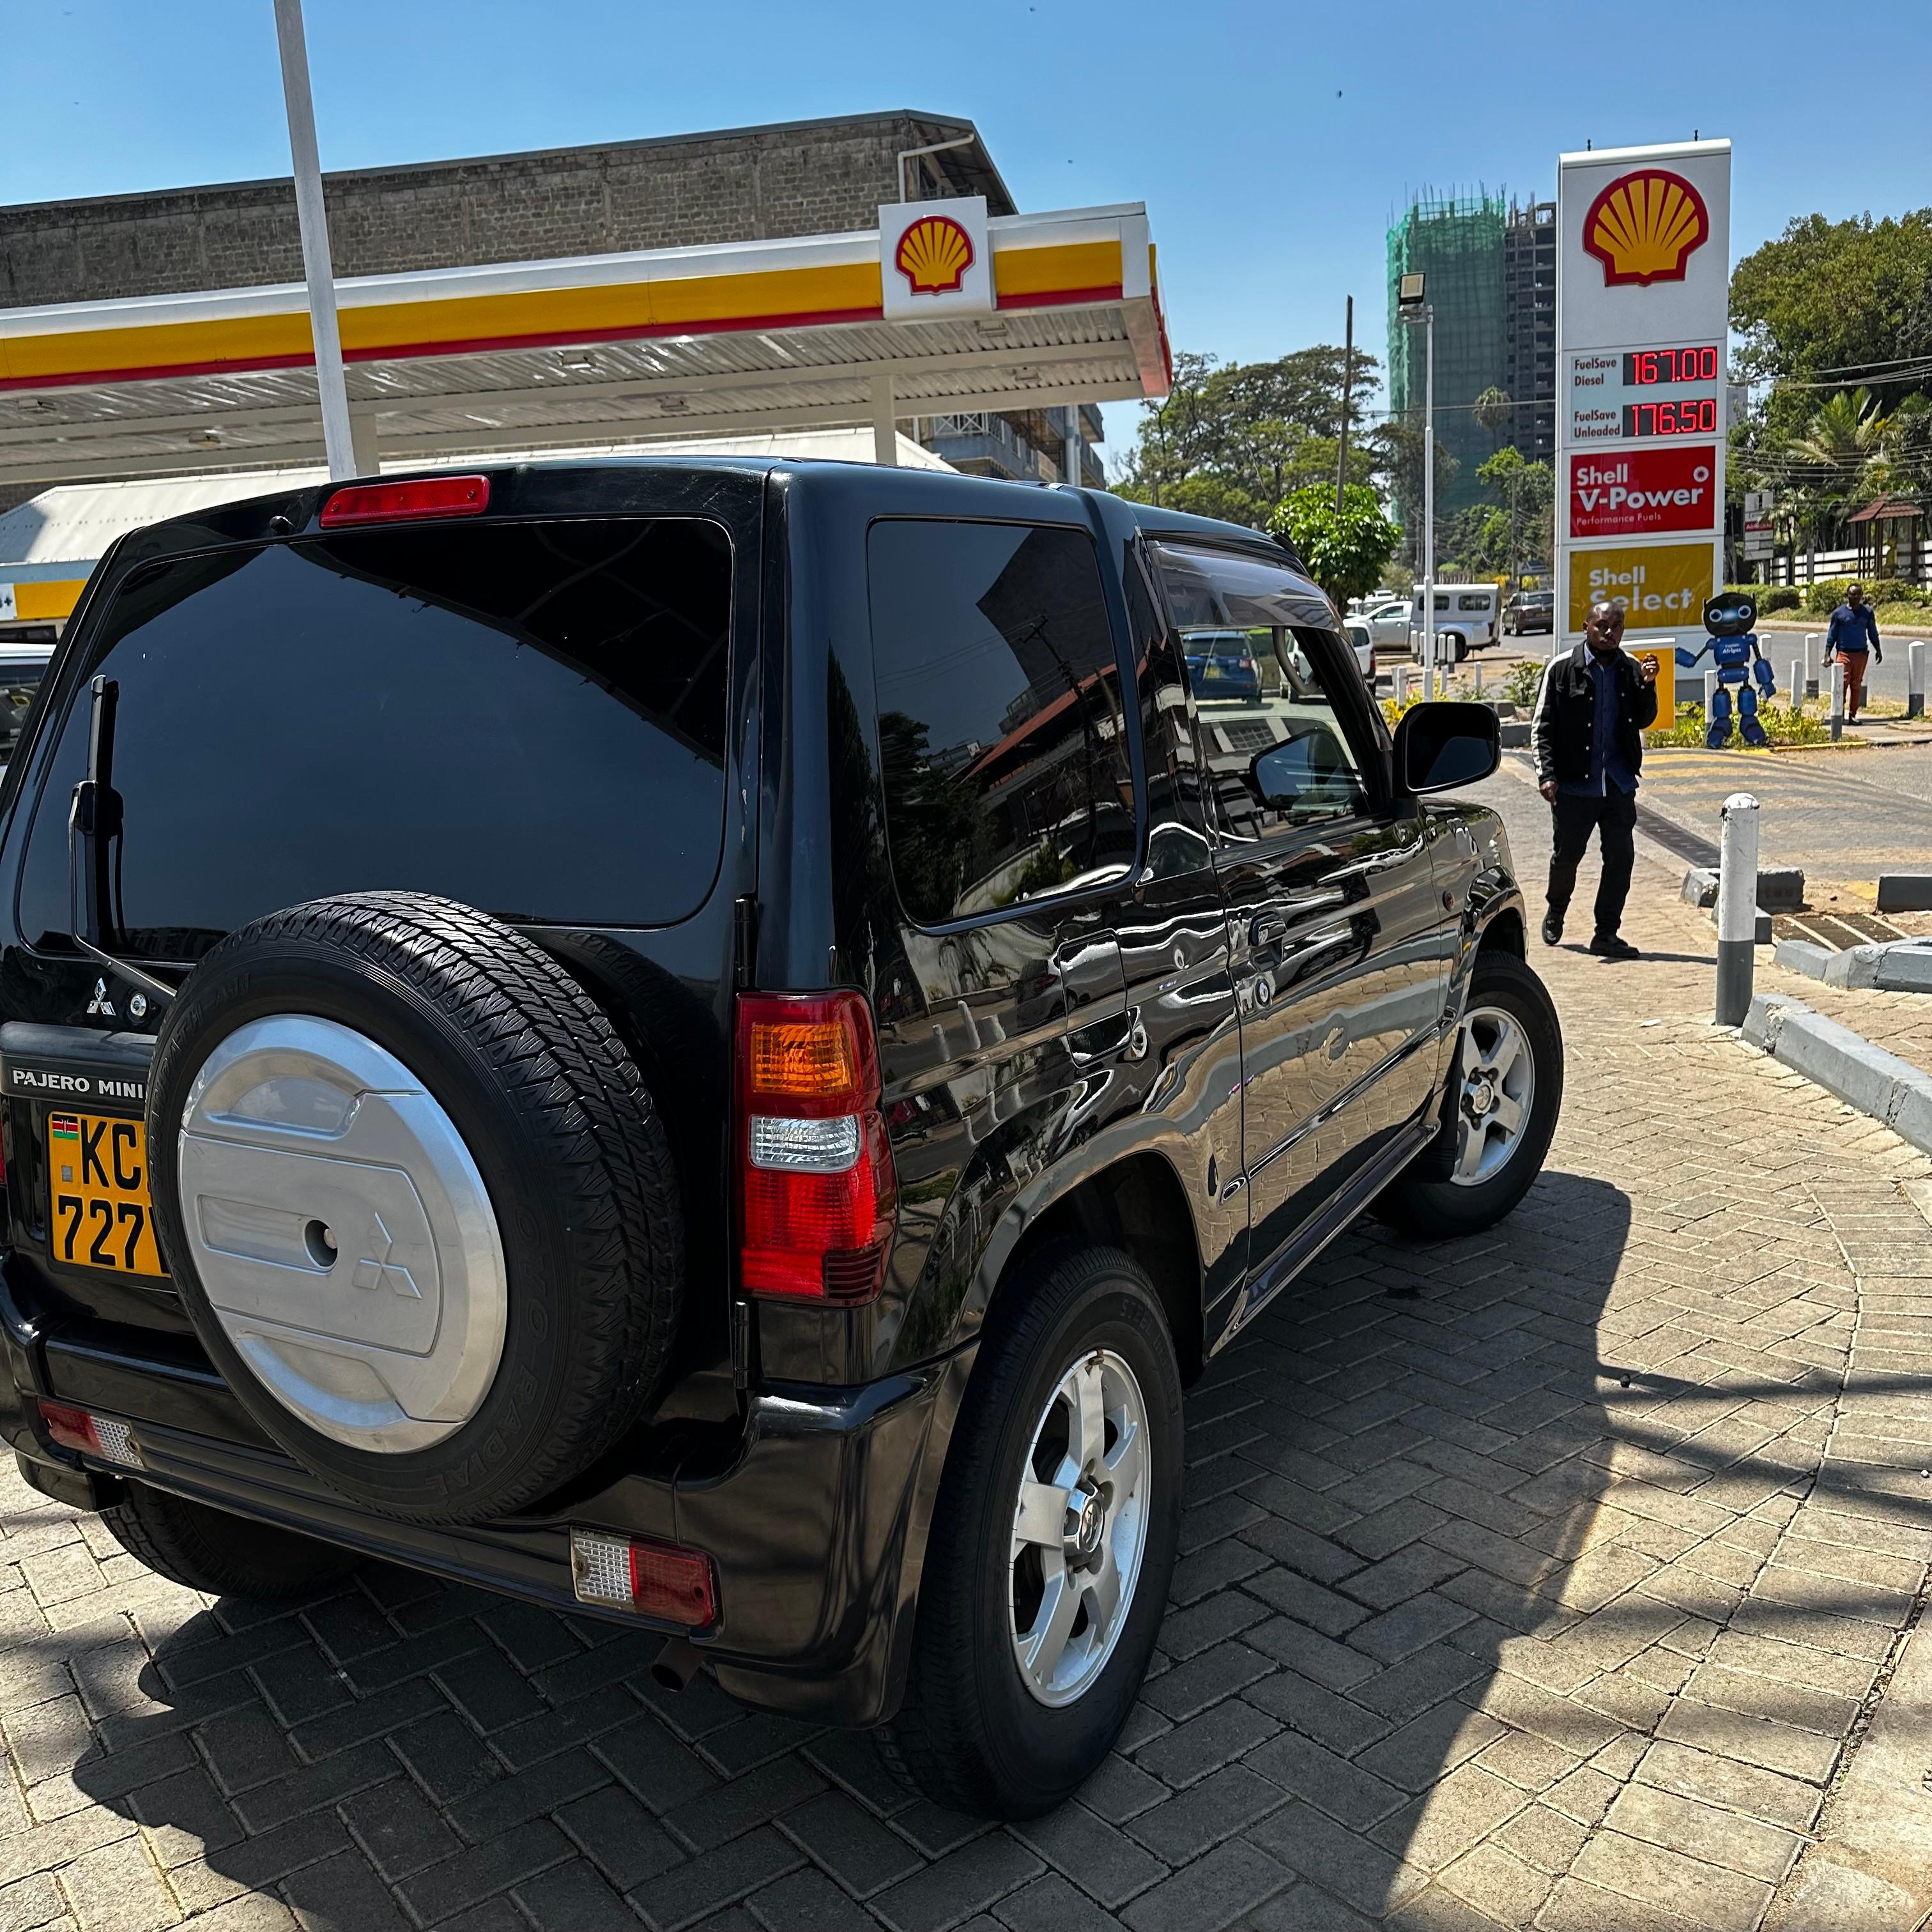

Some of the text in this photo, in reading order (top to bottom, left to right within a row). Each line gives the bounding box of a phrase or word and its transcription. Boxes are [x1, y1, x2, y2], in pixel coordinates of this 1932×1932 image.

[1574, 357, 1617, 370] FuelSave
[1632, 348, 1717, 385] 167.00
[1574, 373, 1604, 386] Diesel
[1574, 410, 1616, 422] FuelSave
[1632, 400, 1715, 436] 176.50
[1574, 424, 1620, 438] Unleaded
[1576, 463, 1629, 486] Shell
[1577, 487, 1704, 512] V-Power
[1576, 512, 1662, 526] Performance Fuels
[1588, 565, 1646, 586] Shell
[13, 1070, 144, 1100] PAJERO MINI
[81, 1119, 150, 1192] KC
[425, 1365, 540, 1497] RADIAL
